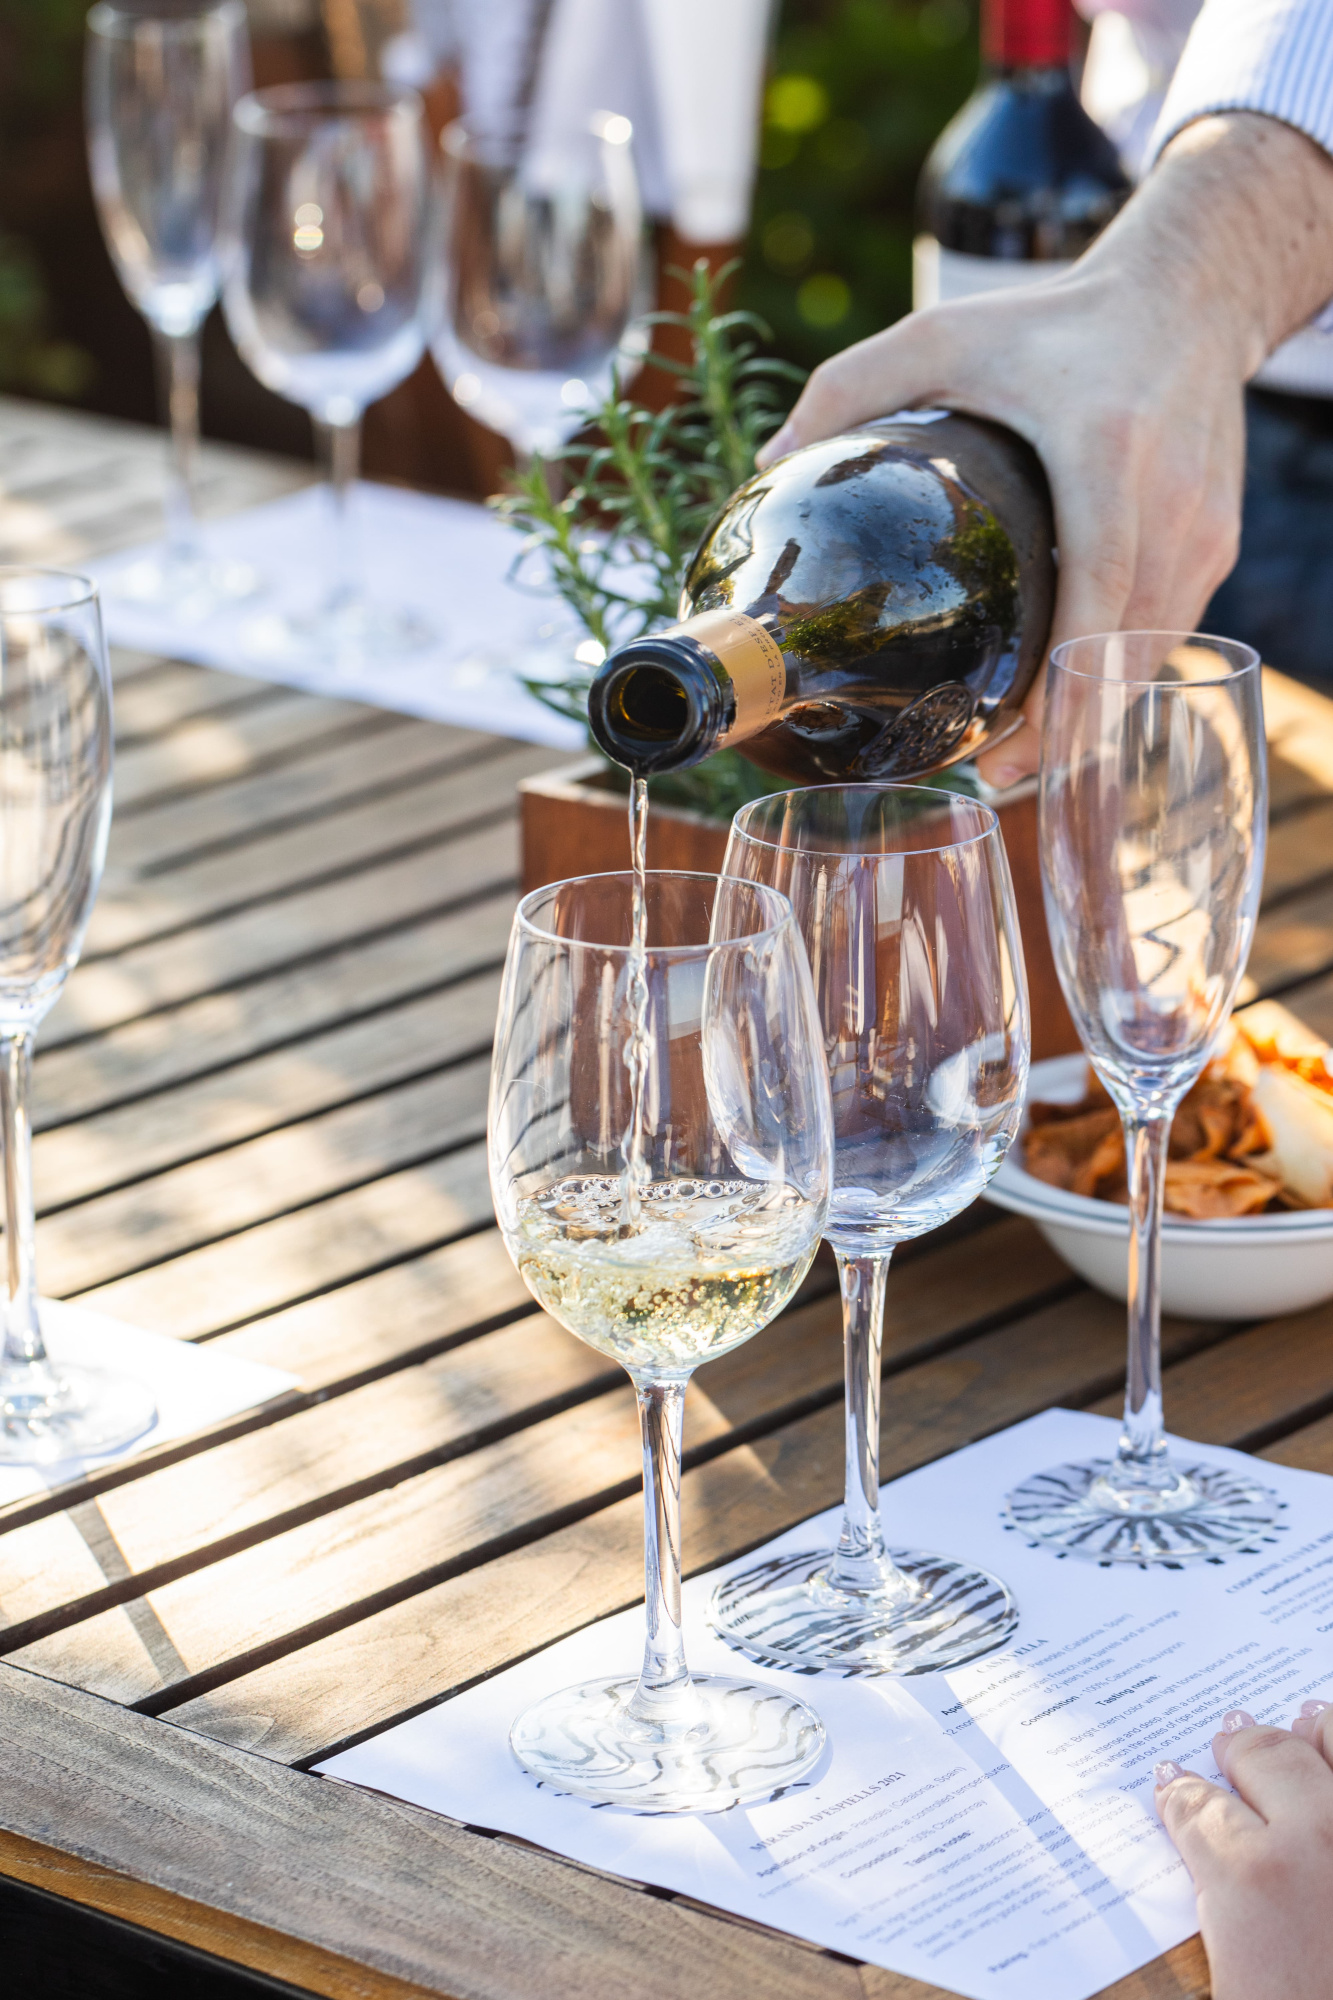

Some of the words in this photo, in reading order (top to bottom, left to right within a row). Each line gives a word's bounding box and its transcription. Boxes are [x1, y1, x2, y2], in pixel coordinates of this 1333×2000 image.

[941, 1691, 984, 1715] Apellation
[998, 1670, 1025, 1683] origin
[976, 1658, 1010, 1673] CASA
[1007, 1639, 1047, 1657] VELLA
[1021, 1695, 1078, 1725] Composition
[1082, 1679, 1109, 1692] 100%
[1105, 1660, 1144, 1683] Cabernet
[1059, 1674, 1083, 1686] years
[1088, 1658, 1114, 1671] bottle
[1095, 1687, 1134, 1705] Tasting
[1131, 1676, 1157, 1689] notes:
[955, 1714, 980, 1730] months
[995, 1696, 1015, 1707] very
[1047, 1664, 1078, 1678] French
[1046, 1741, 1074, 1755] Sight:
[1070, 1727, 1099, 1742] Bright
[1097, 1714, 1126, 1728] cherry
[1122, 1703, 1144, 1715] color
[1143, 1691, 1162, 1703] with
[1175, 1670, 1202, 1686] tones
[1198, 1657, 1226, 1675] typical
[1066, 1751, 1095, 1767] Nose:
[1091, 1737, 1125, 1754] Intense
[1122, 1727, 1141, 1738] and
[1139, 1713, 1165, 1728] deep,
[1161, 1705, 1180, 1715] with
[1186, 1684, 1219, 1702] complex
[1218, 1669, 1247, 1685] palette
[1254, 1646, 1288, 1664] nuances
[1076, 1760, 1109, 1777] among
[1105, 1748, 1131, 1764] which
[1127, 1740, 1145, 1750] the
[1143, 1727, 1168, 1741] notes
[1174, 1713, 1193, 1723] ripe
[1190, 1703, 1207, 1714] red
[1223, 1681, 1251, 1696] spices
[1248, 1671, 1266, 1682] and
[1262, 1656, 1295, 1673] toasted
[1292, 1647, 1312, 1658] nuts
[1118, 1776, 1151, 1791] Palate:
[1281, 1692, 1301, 1704] with
[1298, 1680, 1321, 1694] good
[1120, 1754, 1145, 1768] stand
[1143, 1746, 1163, 1756] out,
[1178, 1724, 1196, 1737] rich
[1192, 1700, 1241, 1728] background
[1248, 1681, 1272, 1696] noble
[749, 1821, 812, 1850] MIRANDA
[810, 1785, 880, 1820] D'ESPIELLS
[877, 1771, 905, 1786] 2021
[818, 1831, 847, 1845] origin
[933, 1766, 966, 1785] Spain)
